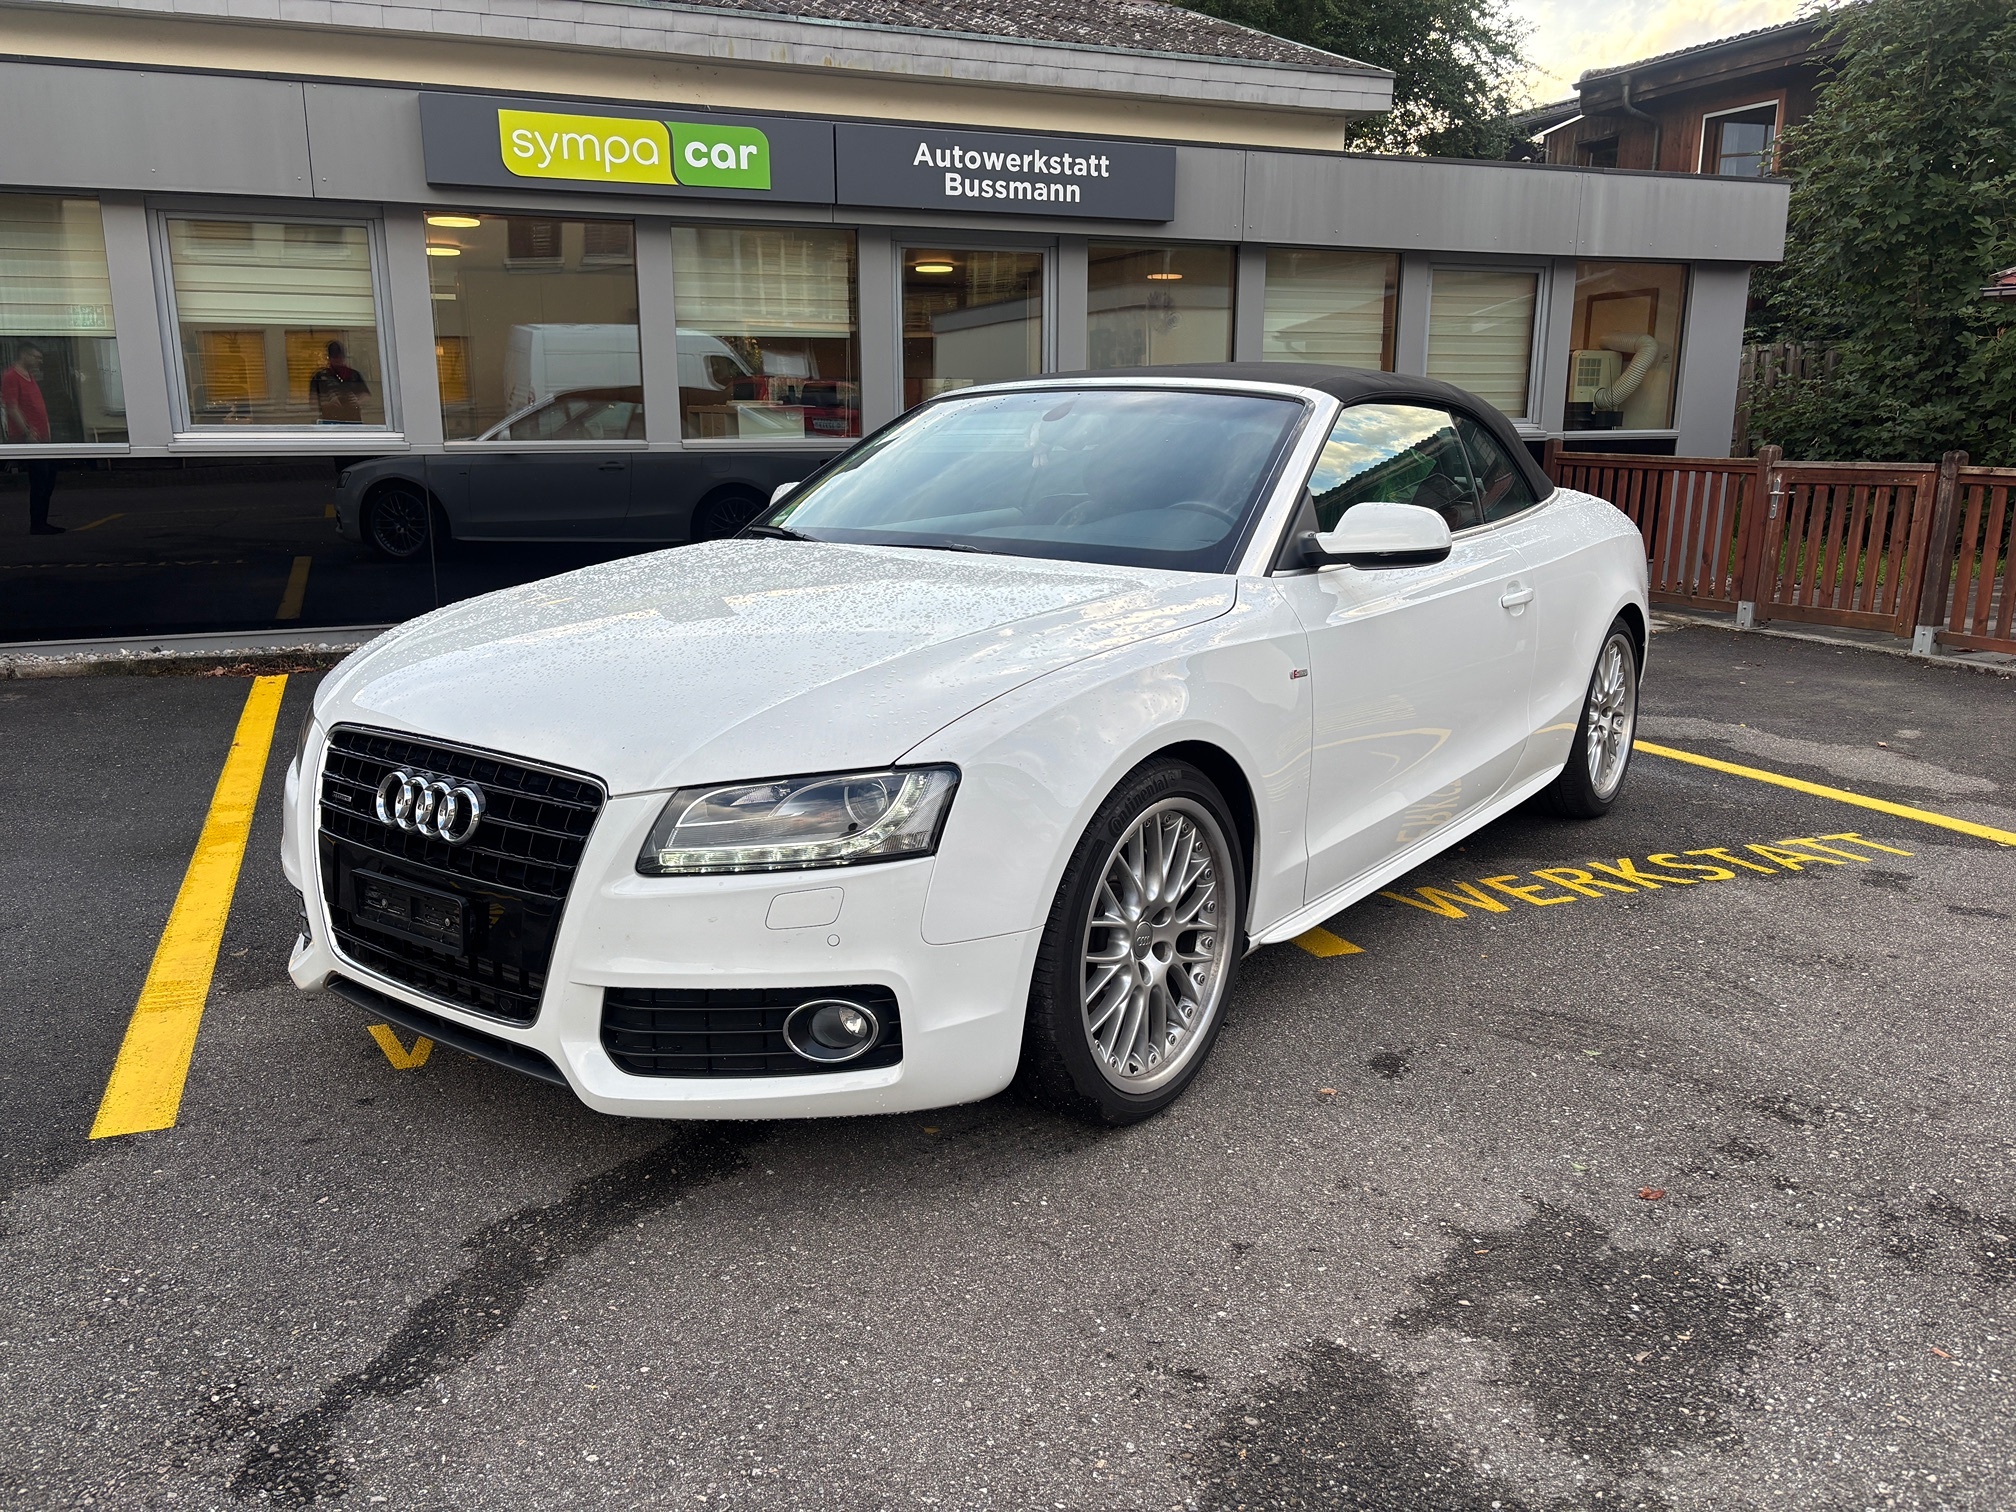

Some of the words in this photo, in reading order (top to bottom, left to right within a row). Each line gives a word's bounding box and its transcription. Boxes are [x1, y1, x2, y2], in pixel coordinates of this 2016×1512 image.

[511, 129, 659, 173] sympa
[684, 141, 758, 170] car
[912, 142, 1110, 178] Autowerkstatt
[945, 172, 1081, 203] Bussmann
[1108, 774, 1169, 838] Continental
[1379, 832, 1914, 920] WERKSTATT
